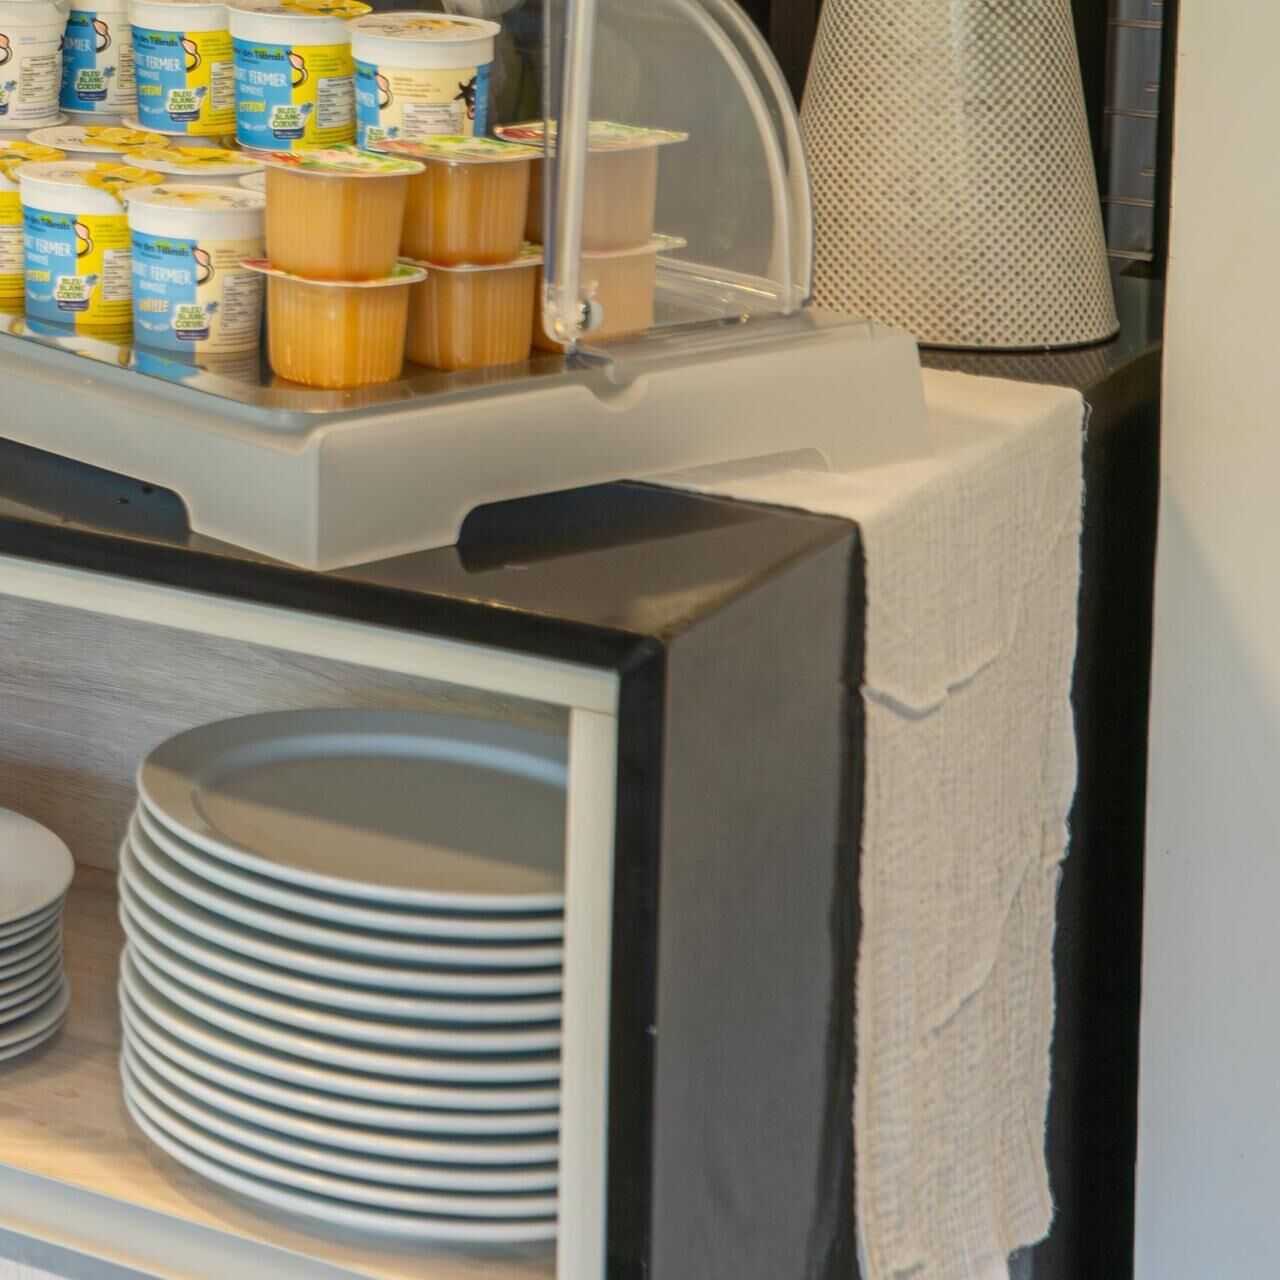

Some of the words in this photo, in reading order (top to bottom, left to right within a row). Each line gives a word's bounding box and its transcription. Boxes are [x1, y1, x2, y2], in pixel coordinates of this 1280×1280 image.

[146, 56, 183, 72] FERMIER
[250, 71, 289, 89] FERMIER
[173, 90, 192, 98] BLEU
[171, 96, 195, 104] BLANC
[275, 113, 301, 121] BLANC
[34, 238, 74, 258] FERMIER
[150, 266, 192, 286] FERMIER
[62, 277, 81, 285] BLEU
[59, 283, 84, 291] BLANC
[180, 306, 202, 314] BLEU
[177, 313, 206, 321] BLANC
